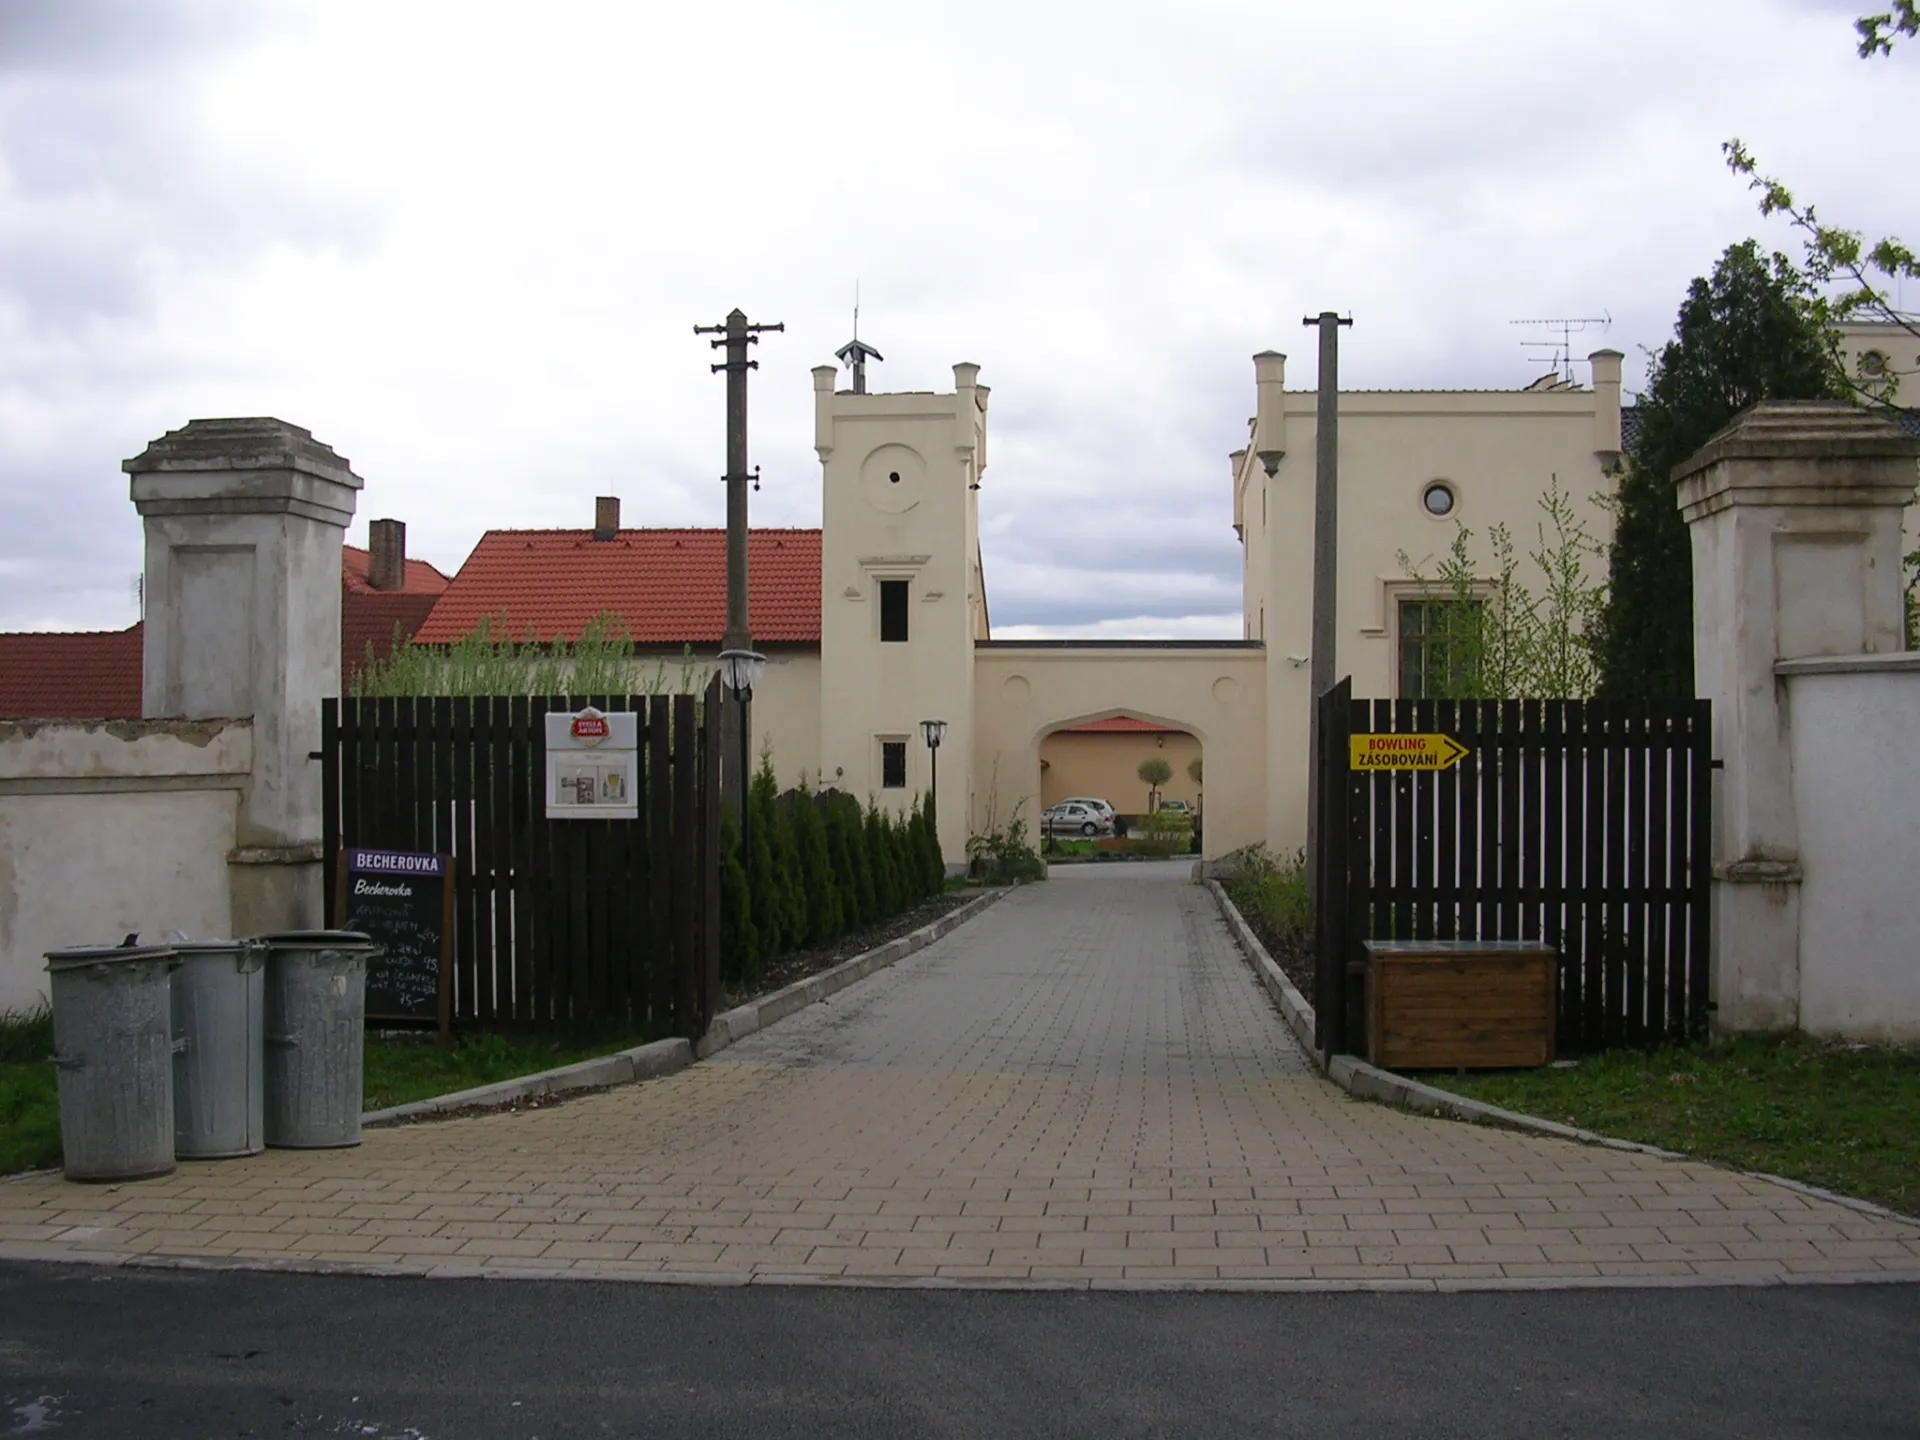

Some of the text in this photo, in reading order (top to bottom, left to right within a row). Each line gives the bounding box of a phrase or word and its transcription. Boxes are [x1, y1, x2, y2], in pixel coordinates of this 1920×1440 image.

[1368, 739, 1426, 750] BOWLING
[1359, 751, 1438, 766] ZÁSOBOVÁNÍ
[356, 853, 438, 872] BECHEROVKA
[354, 879, 412, 896] Becherovka
